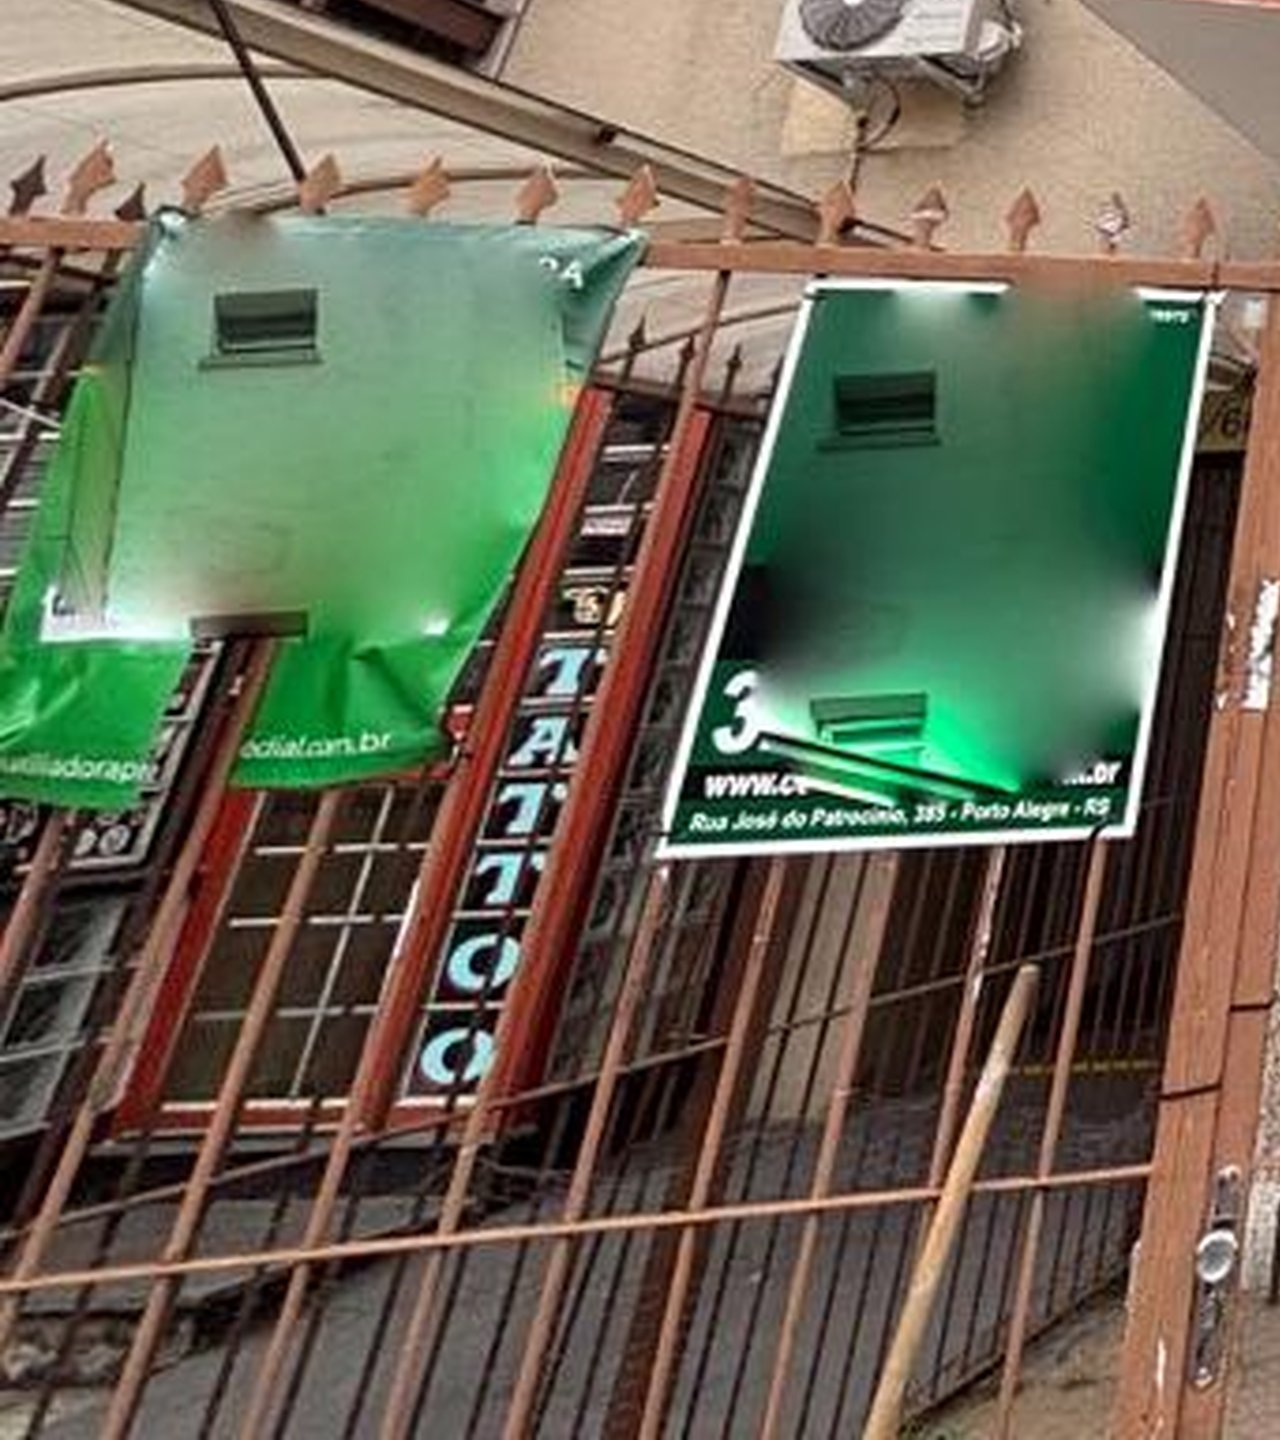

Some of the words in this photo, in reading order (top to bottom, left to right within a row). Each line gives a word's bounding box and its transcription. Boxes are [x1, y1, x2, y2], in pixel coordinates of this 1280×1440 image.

[420, 647, 612, 1086] TATTOO
[689, 813, 729, 832] Rua
[781, 808, 807, 829] do
[960, 801, 1010, 823] Porto
[1012, 799, 1071, 823] Alegre
[1083, 796, 1111, 817] RS
